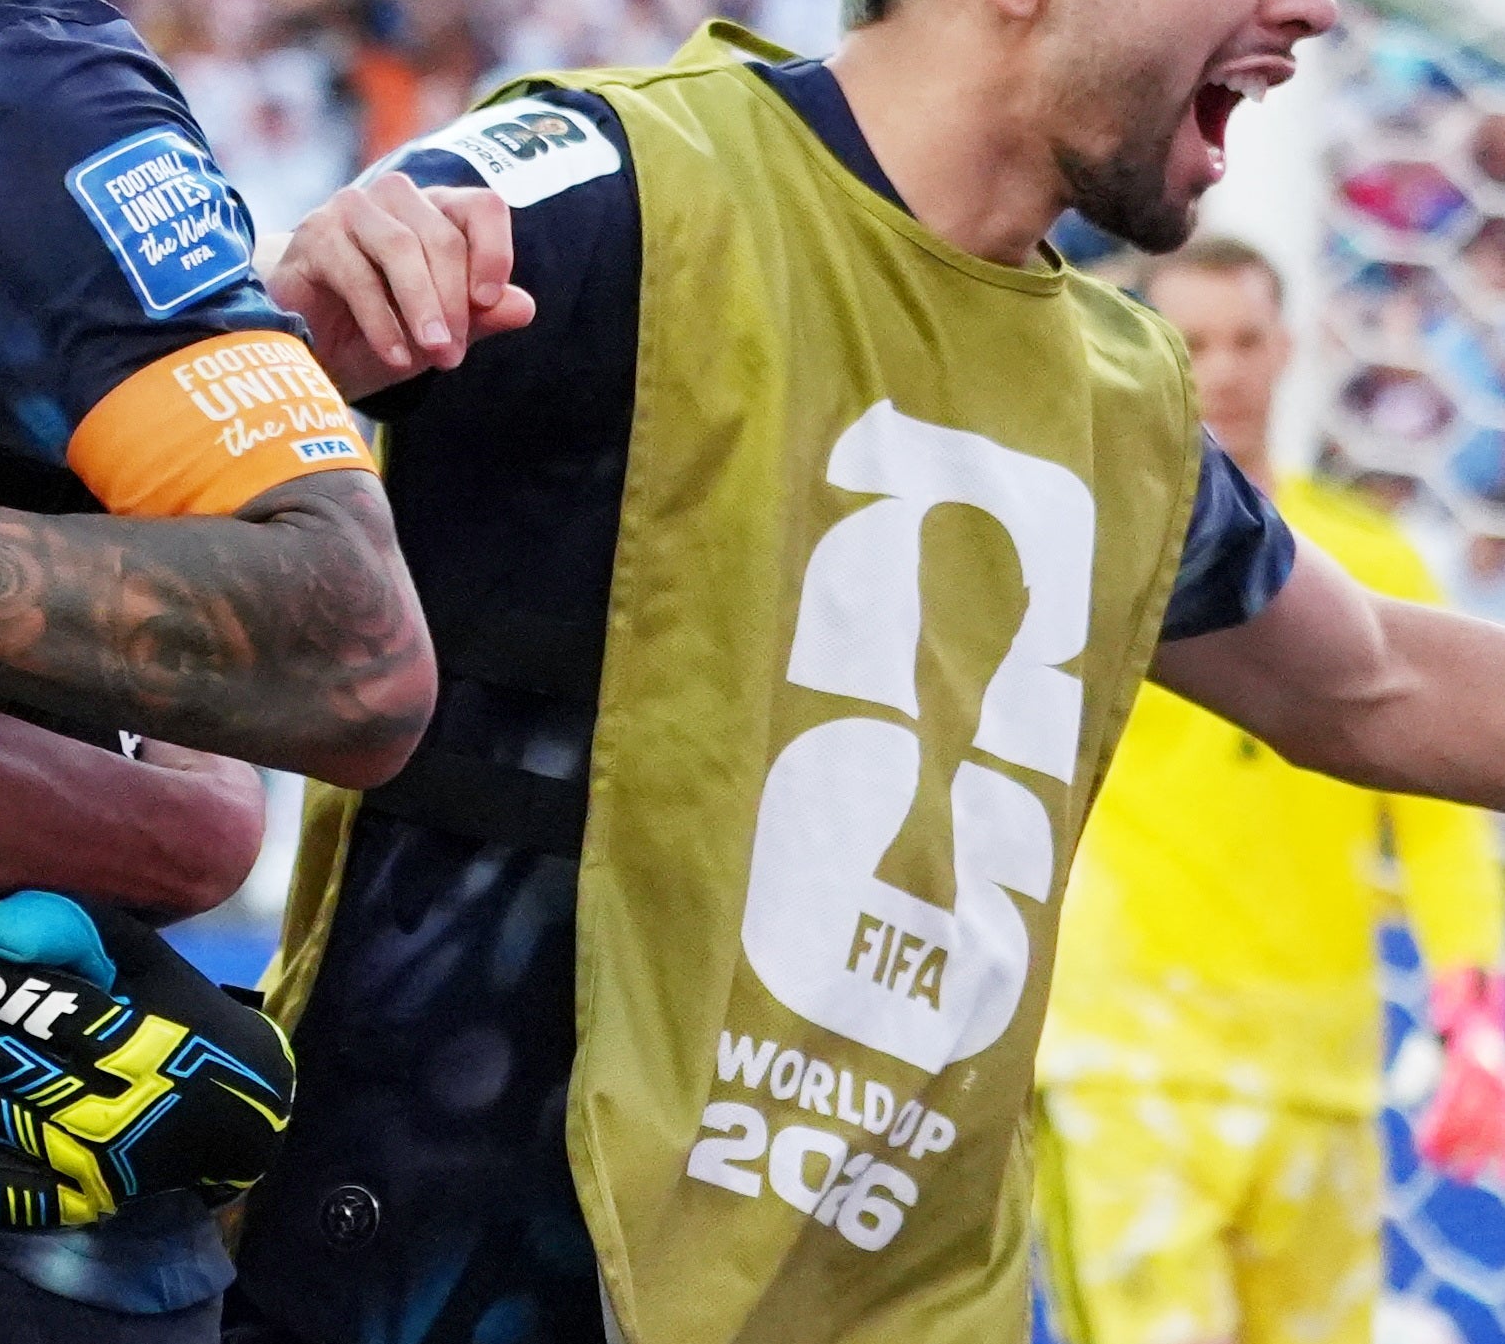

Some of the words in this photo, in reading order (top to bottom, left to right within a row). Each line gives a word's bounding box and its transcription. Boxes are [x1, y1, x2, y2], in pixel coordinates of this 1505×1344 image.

[105, 150, 189, 204] FOOTBALL
[120, 174, 211, 234] UNITES
[138, 232, 178, 266] the
[171, 200, 221, 248] World
[180, 244, 216, 271] FIFA
[214, 418, 285, 457] the
[300, 439, 354, 458] FIFA
[845, 910, 950, 1012] FIFA
[716, 1029, 897, 1136] WORLD
